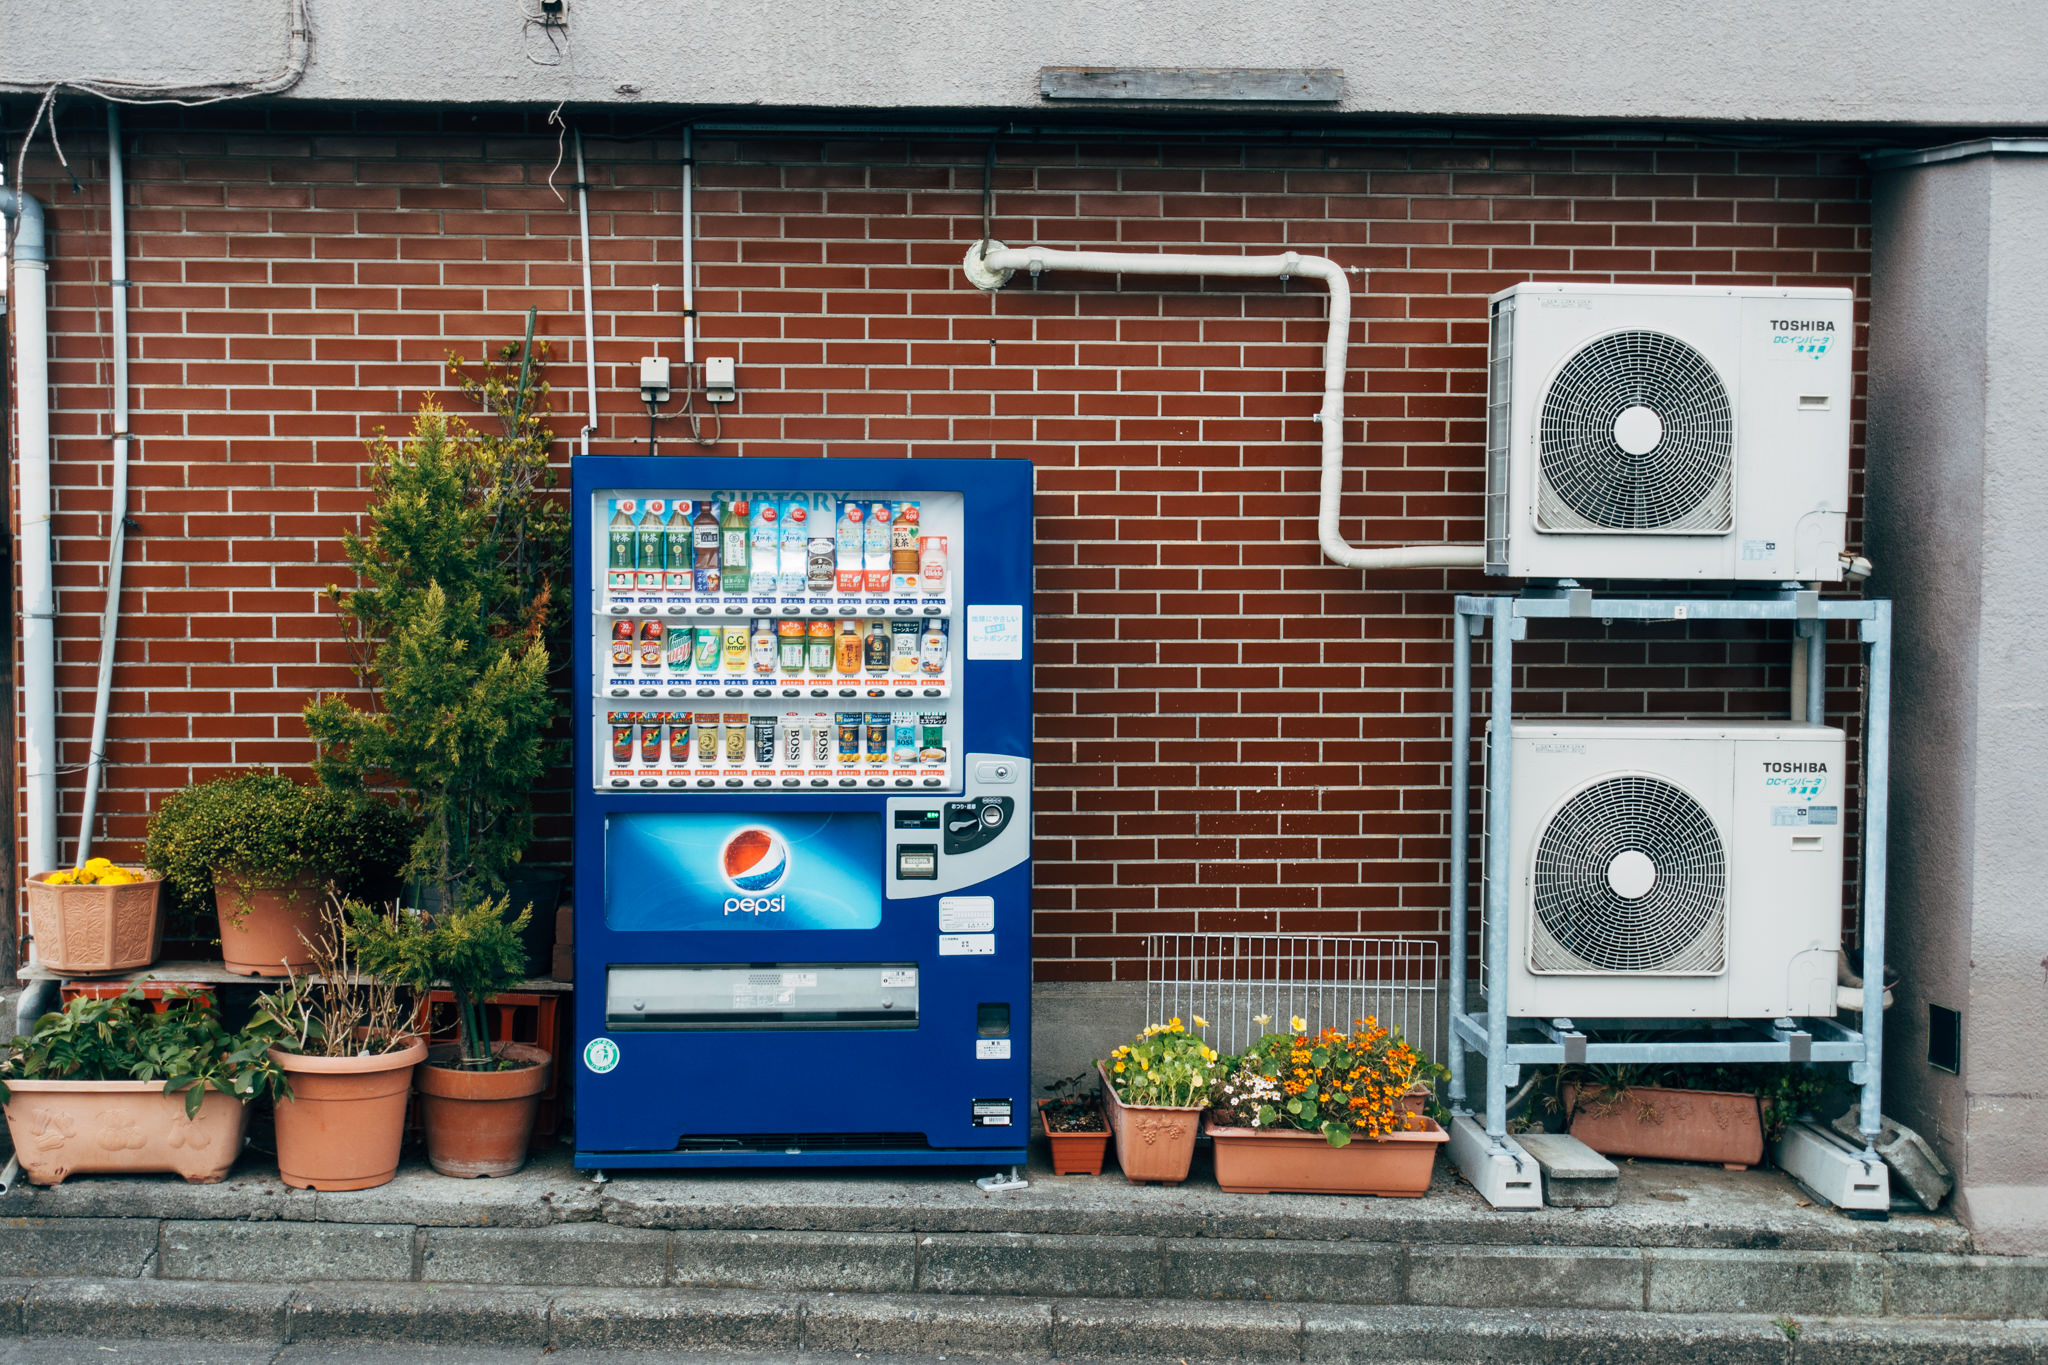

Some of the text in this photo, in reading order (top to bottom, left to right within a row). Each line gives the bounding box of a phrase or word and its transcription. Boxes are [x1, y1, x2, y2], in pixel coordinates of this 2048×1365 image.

[1770, 320, 1835, 331] TOSHIBA
[613, 533, 630, 542] 特茶
[641, 533, 658, 543] 特茶
[669, 534, 687, 543] 特茶
[894, 538, 909, 547] 麦茶
[762, 728, 773, 761] BLACK
[790, 729, 800, 760] BOSS
[818, 730, 828, 761] BOSS
[1763, 762, 1828, 773] TOSHIBA
[723, 894, 785, 916] pepsi
